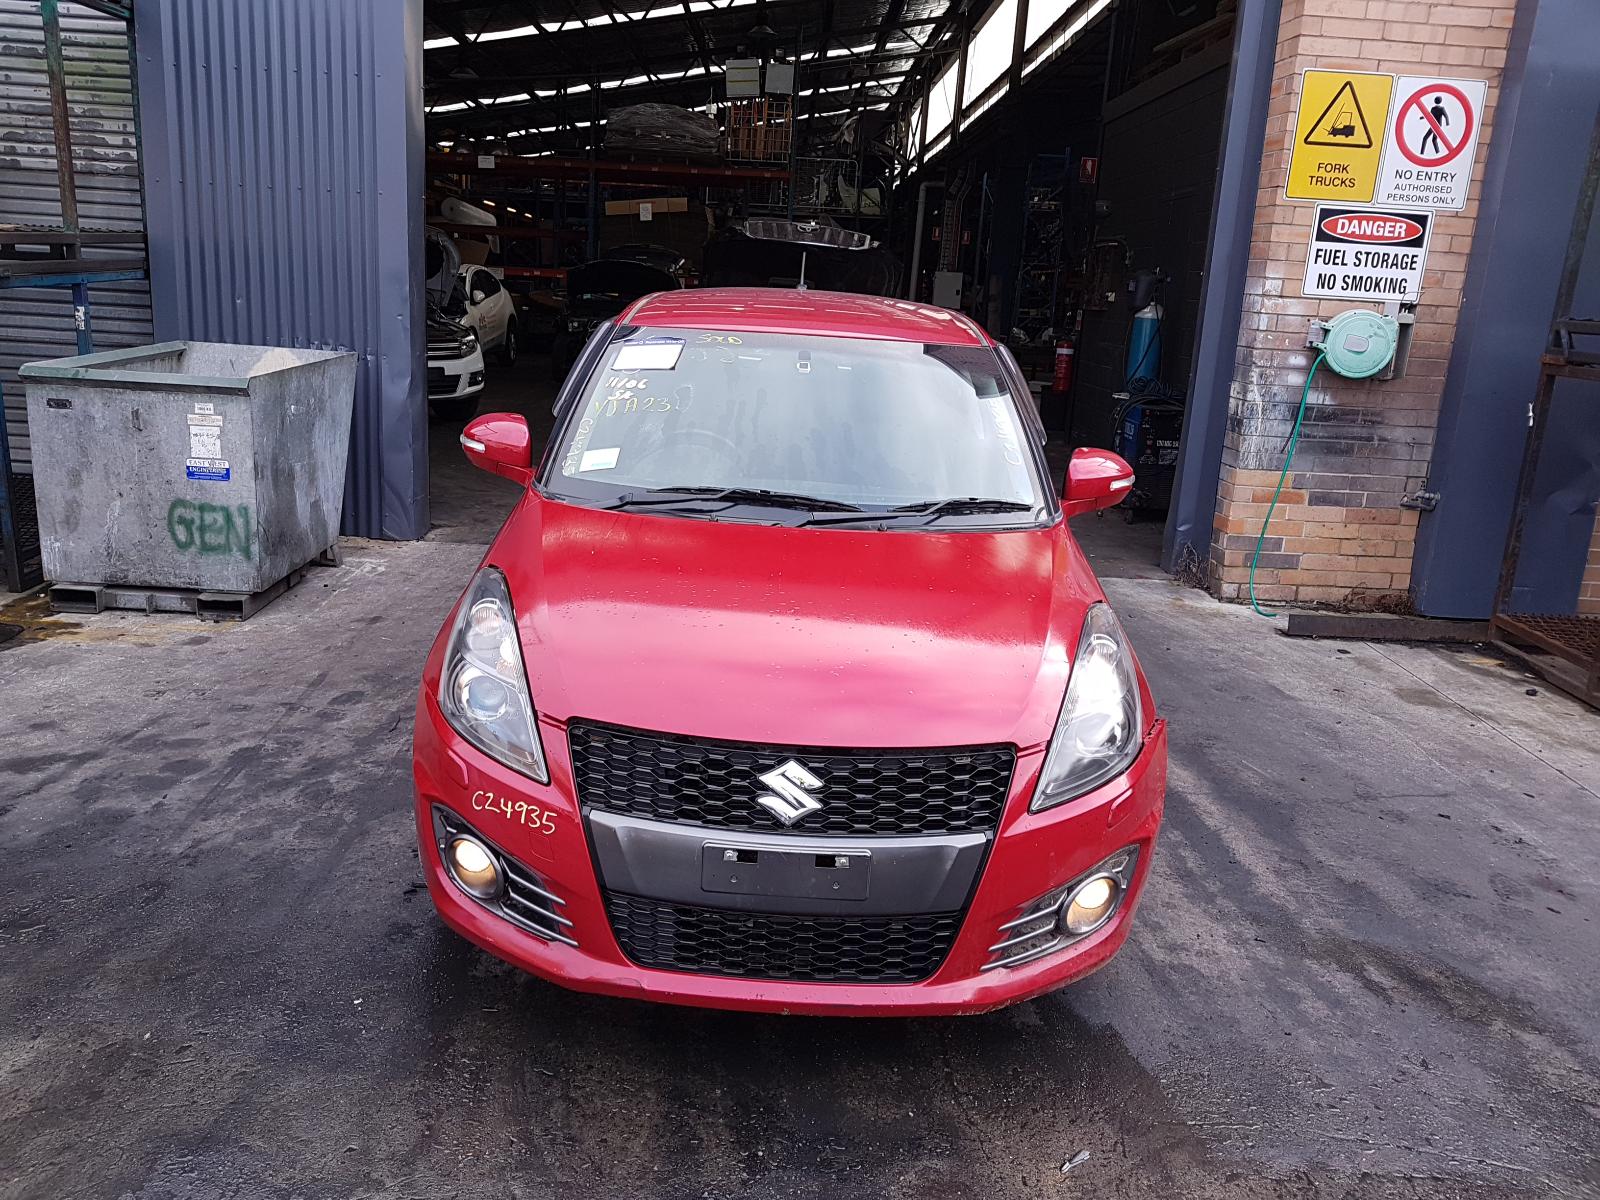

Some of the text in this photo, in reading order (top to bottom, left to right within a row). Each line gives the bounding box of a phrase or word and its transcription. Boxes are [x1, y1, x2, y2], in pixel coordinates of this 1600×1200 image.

[1317, 162, 1350, 174] FORK
[1394, 169, 1457, 183] NO ENTRY
[1308, 175, 1356, 188] TRUCKS
[1393, 183, 1453, 194] AUTHORISED
[1386, 193, 1456, 205] PERSONS ONLY
[1336, 218, 1407, 238] DANGER
[1314, 248, 1419, 271] FUEL STORAGE
[1316, 272, 1408, 295] NO SMOKING
[167, 499, 251, 560] GEN
[472, 790, 558, 835] C24935
